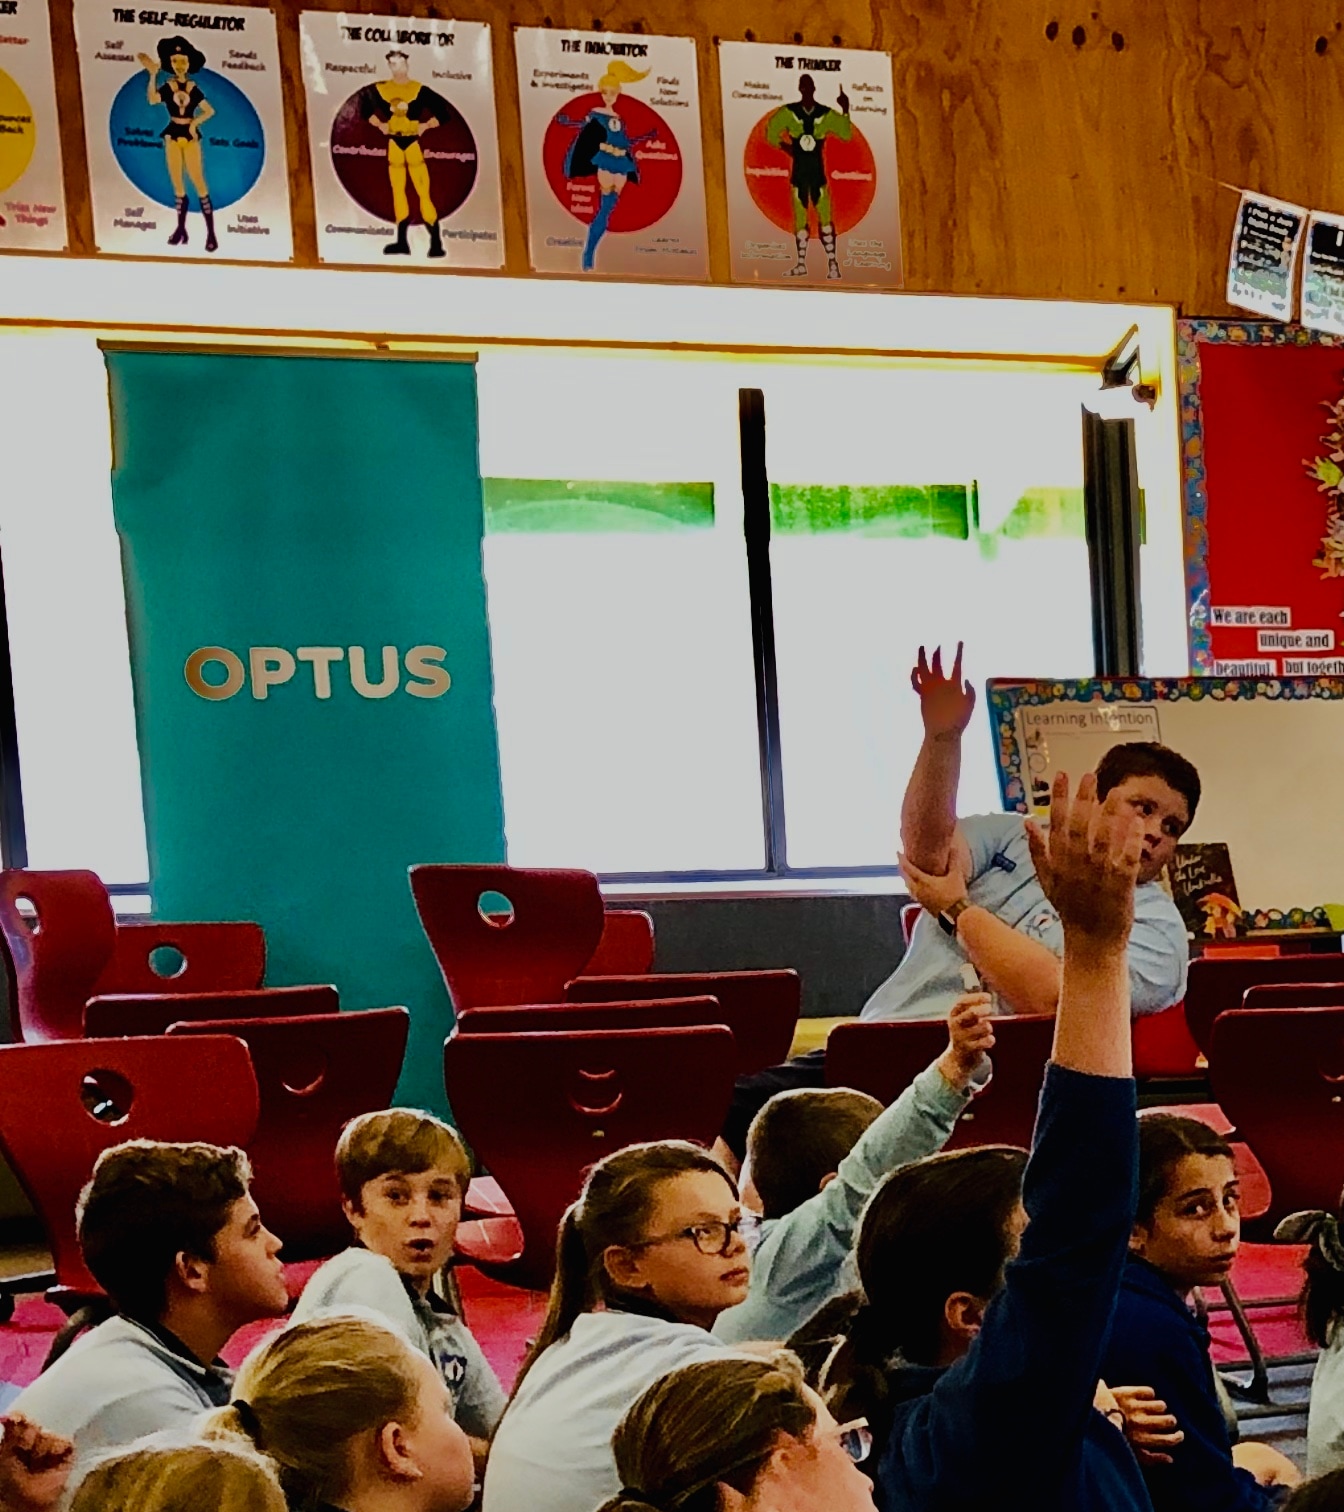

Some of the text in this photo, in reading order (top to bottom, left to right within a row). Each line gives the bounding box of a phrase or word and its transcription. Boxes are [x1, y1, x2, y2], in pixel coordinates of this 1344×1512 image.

[113, 8, 246, 31] THE SELF-REGULATOR
[561, 39, 581, 53] THE
[775, 56, 841, 72] THE THINKER
[1213, 608, 1288, 625] We are each
[1260, 633, 1329, 649] unique and
[184, 645, 451, 701] OPTUS
[1285, 660, 1303, 675] but
[1026, 712, 1087, 728] Learning
